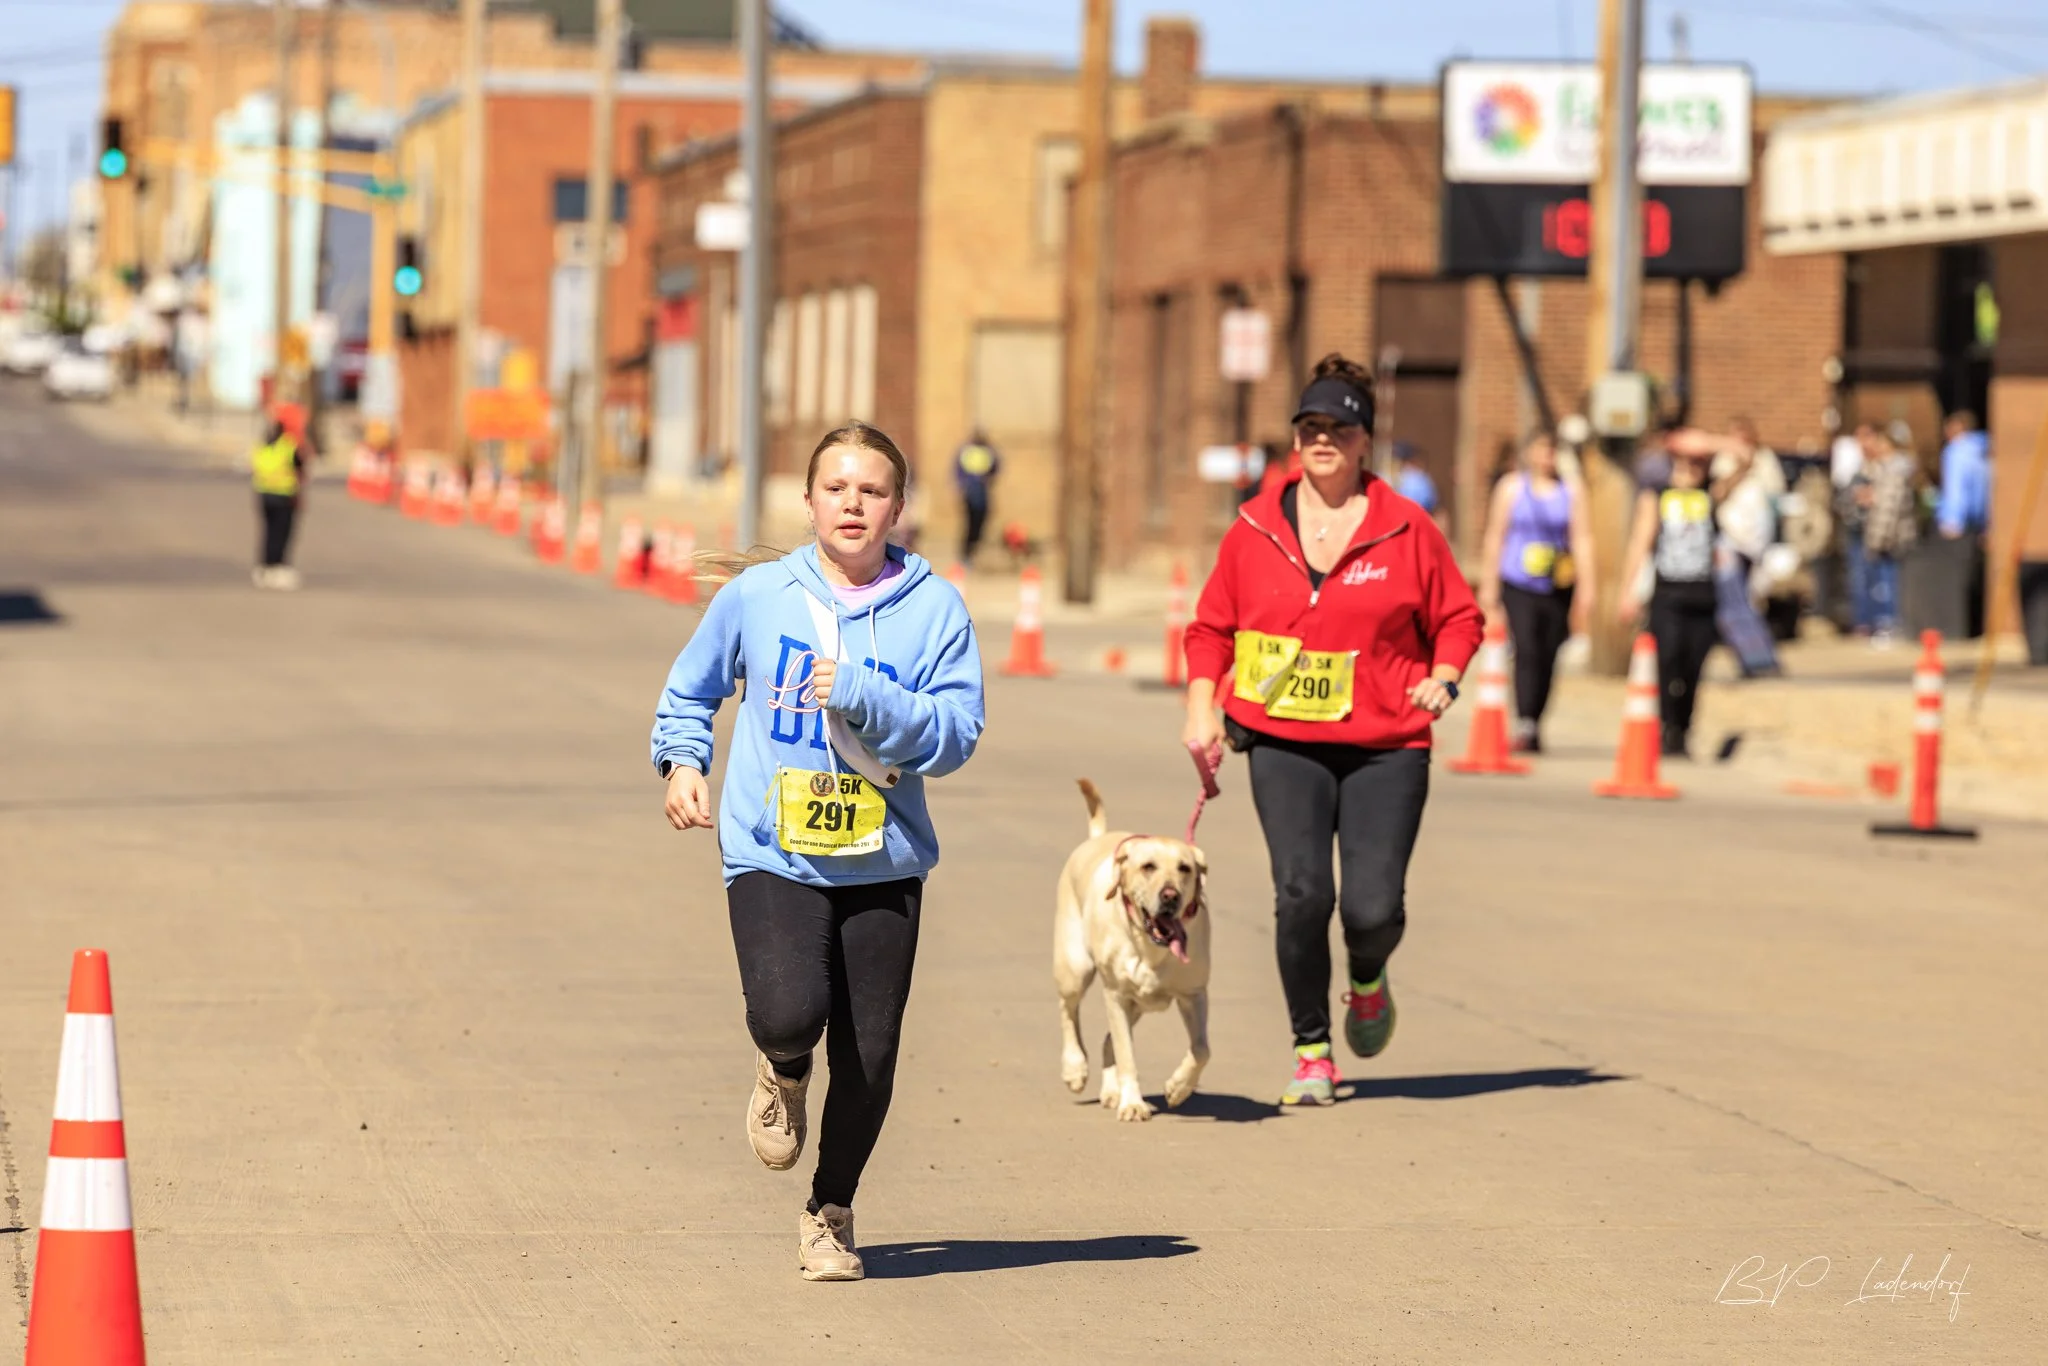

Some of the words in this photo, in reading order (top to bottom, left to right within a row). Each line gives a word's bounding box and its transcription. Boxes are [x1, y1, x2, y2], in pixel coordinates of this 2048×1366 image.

[1315, 657, 1333, 670] 5K
[1289, 674, 1331, 700] 290
[840, 778, 862, 795] 5K
[806, 801, 857, 832] 291
